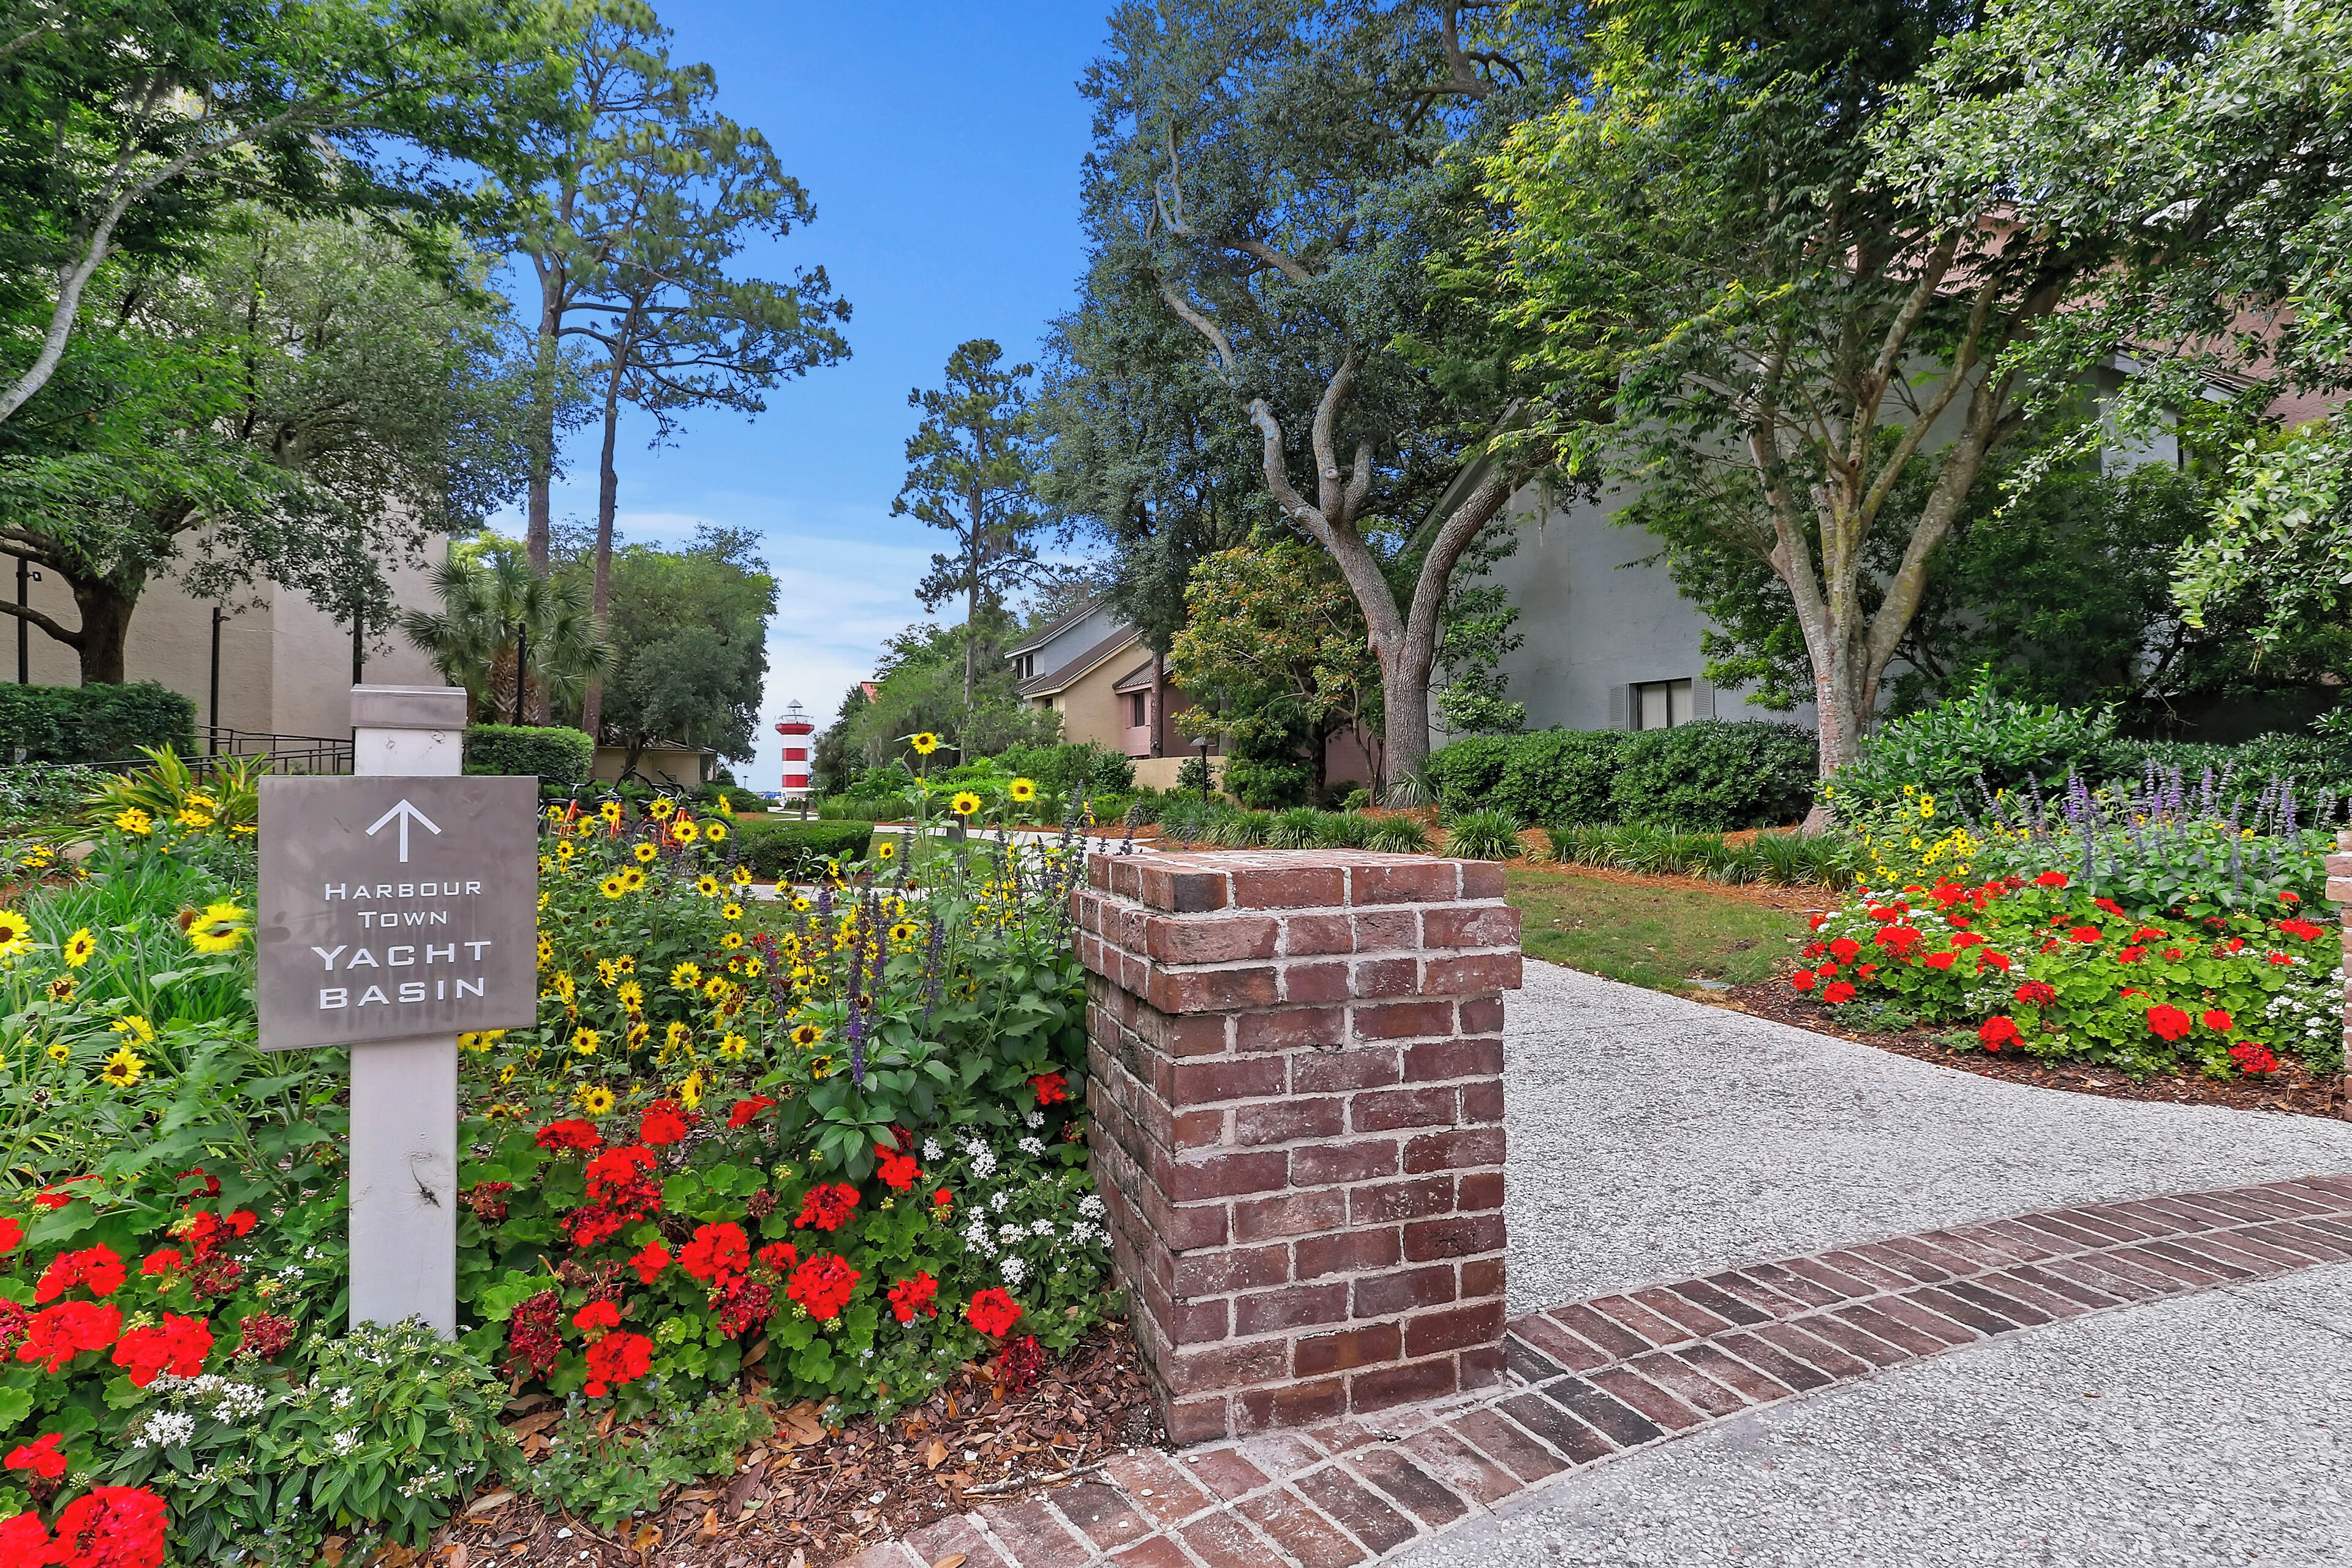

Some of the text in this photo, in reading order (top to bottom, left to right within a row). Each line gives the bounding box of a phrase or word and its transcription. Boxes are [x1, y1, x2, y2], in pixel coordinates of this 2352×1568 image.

[325, 881, 482, 901] HARBOUR
[358, 911, 447, 928] TOWN
[311, 941, 491, 971] YACHT
[320, 978, 484, 1009] BASIN
